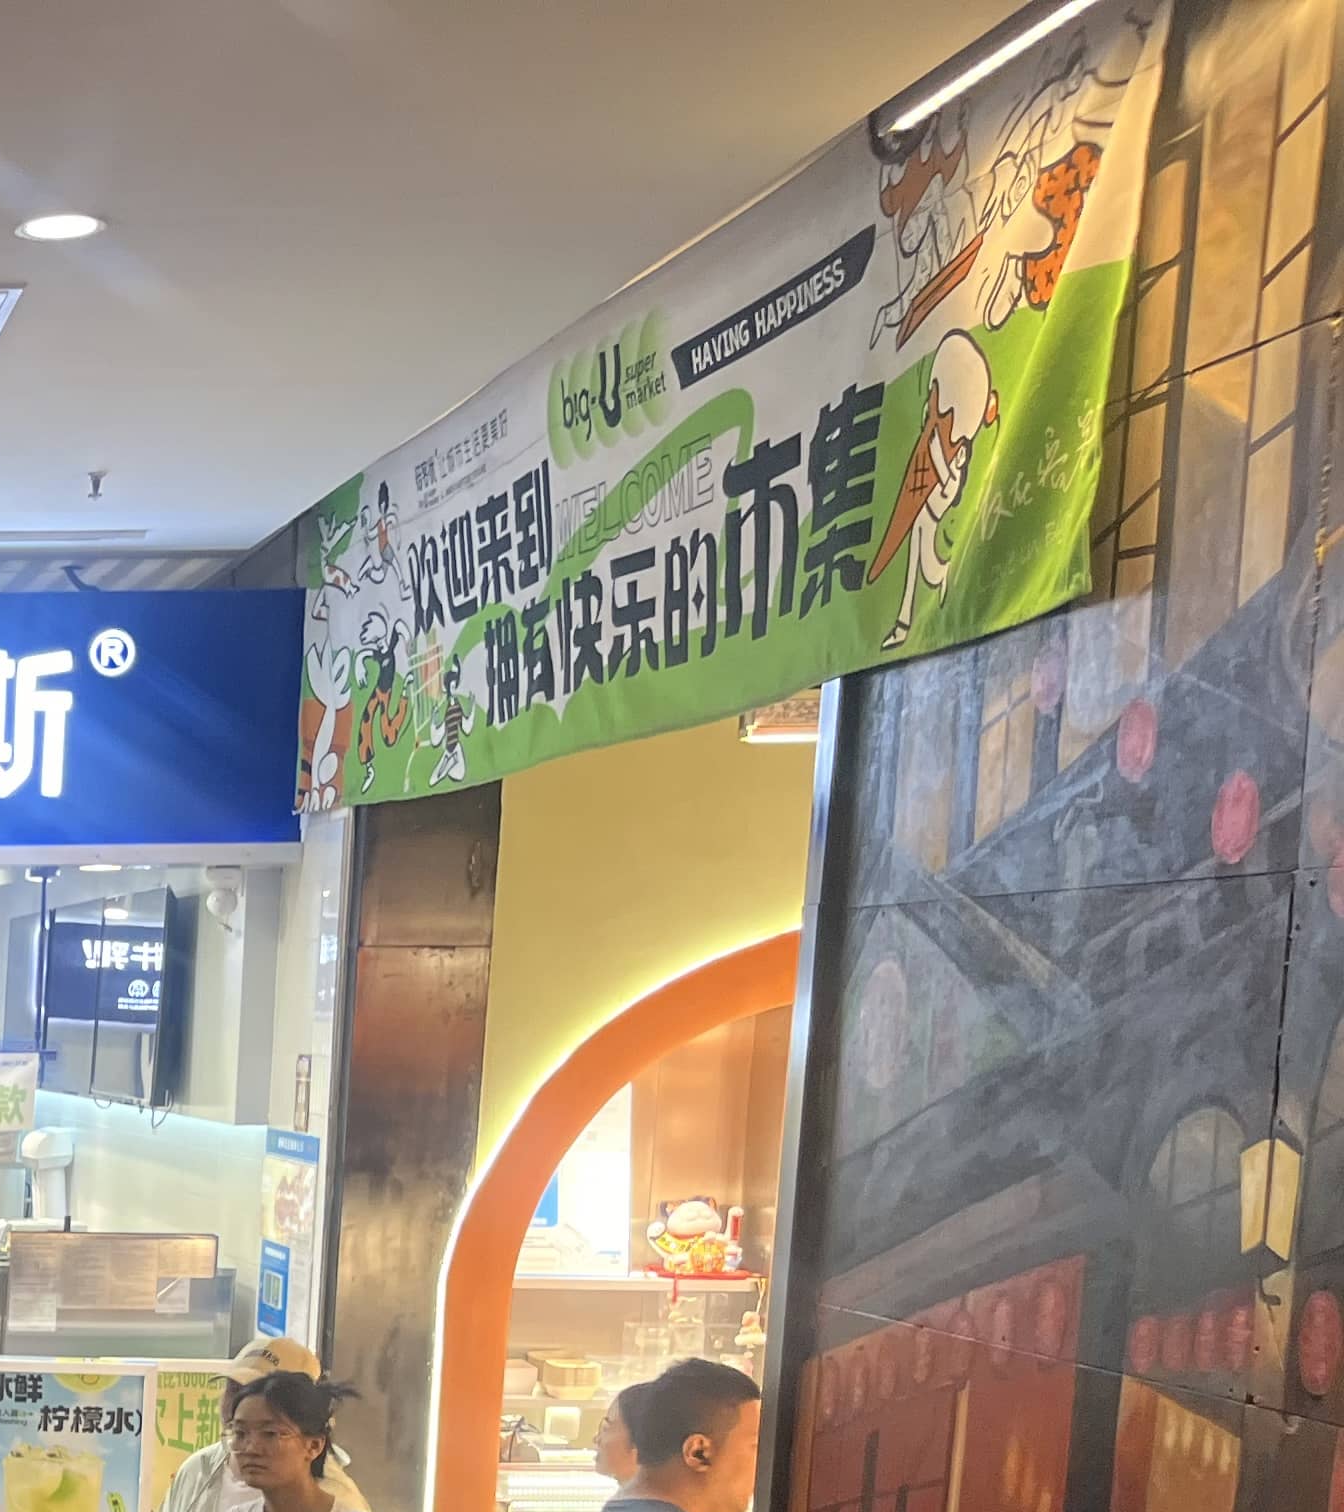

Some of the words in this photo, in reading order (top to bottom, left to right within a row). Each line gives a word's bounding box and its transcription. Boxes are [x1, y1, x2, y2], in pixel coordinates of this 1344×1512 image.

[624, 351, 656, 383] super
[691, 319, 750, 375] HAVING
[754, 257, 845, 340] HAPPINESS
[626, 371, 667, 410] market
[408, 457, 553, 637] 欢迎来到
[483, 381, 886, 728] 拥有快乐的市集
[555, 433, 714, 563] WELCOME
